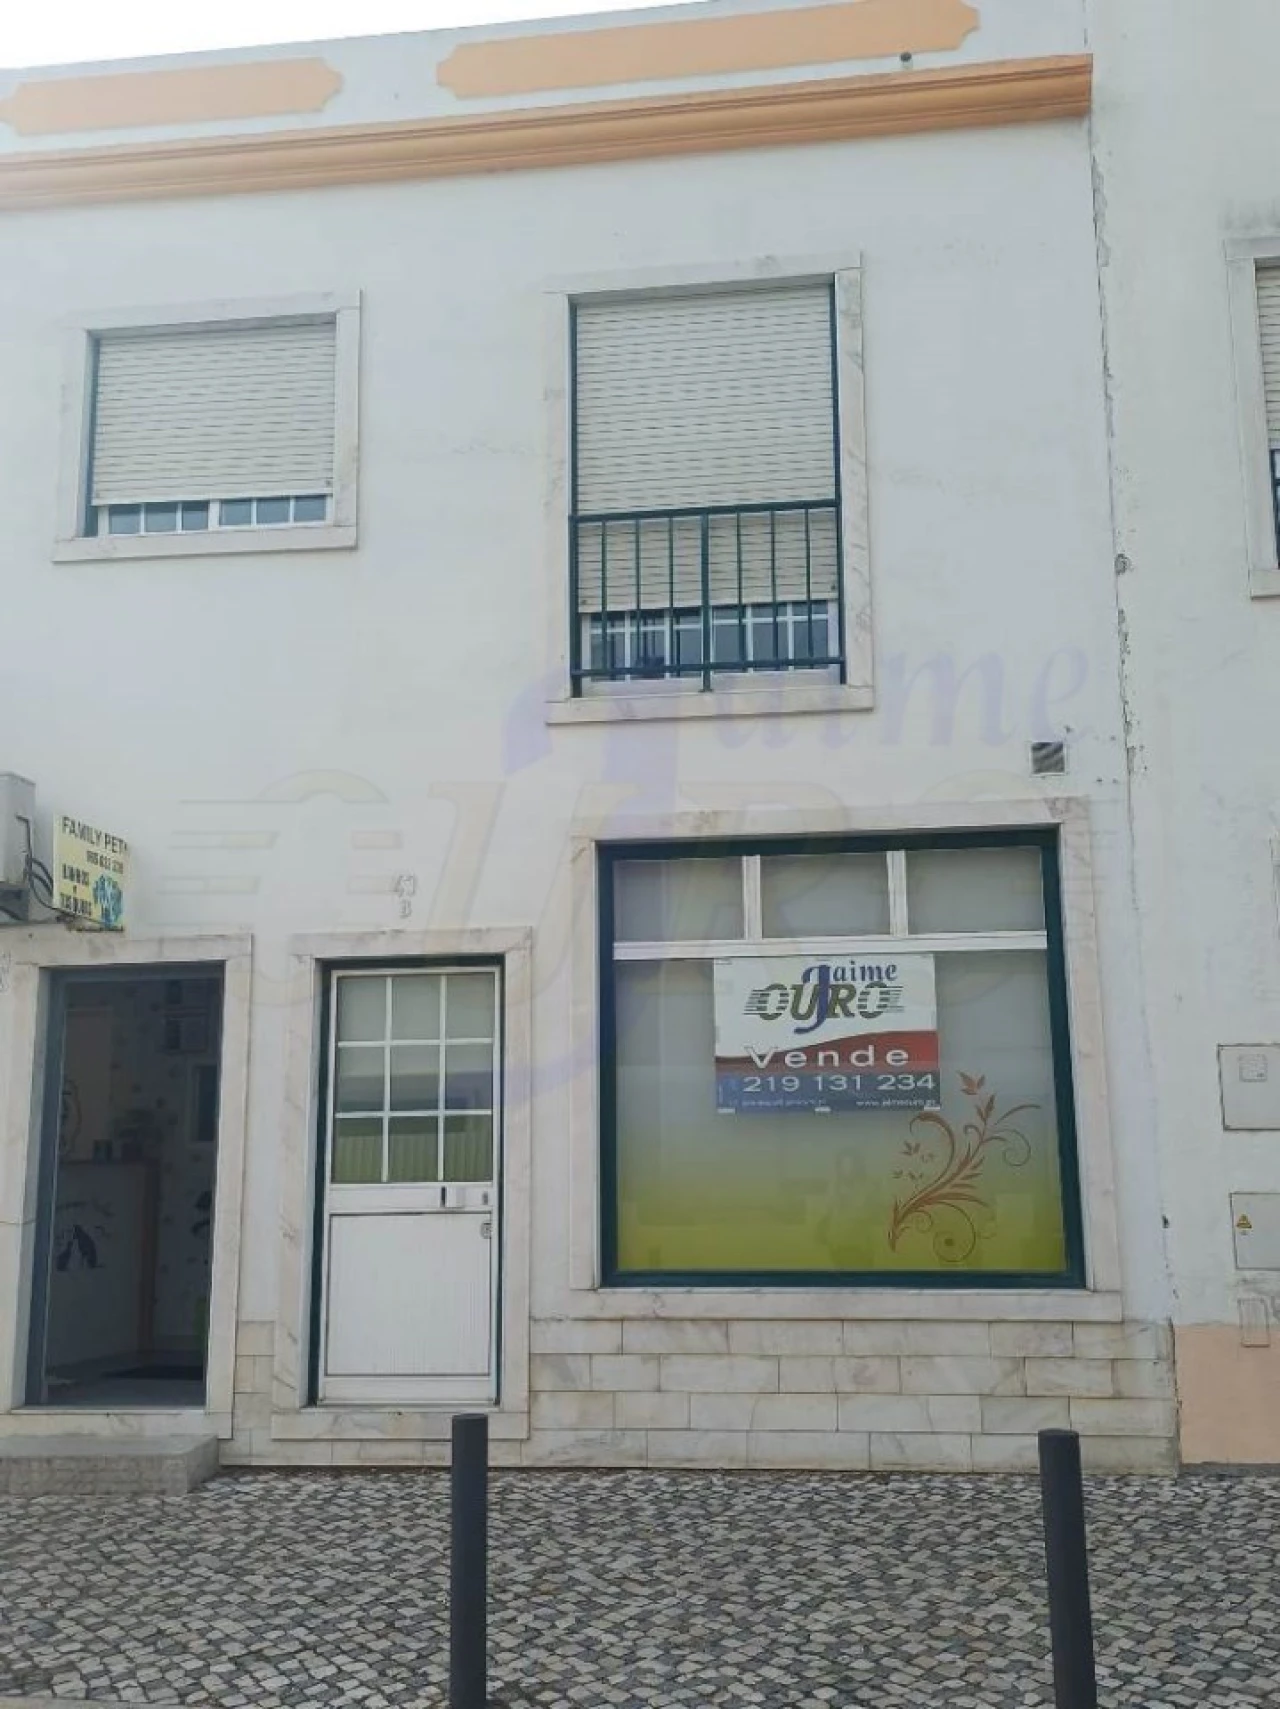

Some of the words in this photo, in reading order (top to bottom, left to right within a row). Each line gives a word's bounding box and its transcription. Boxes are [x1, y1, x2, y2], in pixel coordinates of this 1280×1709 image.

[62, 816, 102, 847] FAMILY
[744, 981, 904, 1021] OURO
[794, 961, 898, 1034] Jaime
[744, 1045, 909, 1069] Vende
[743, 1076, 800, 1092] 219
[814, 1075, 862, 1091] 131
[877, 1074, 935, 1090] 234
